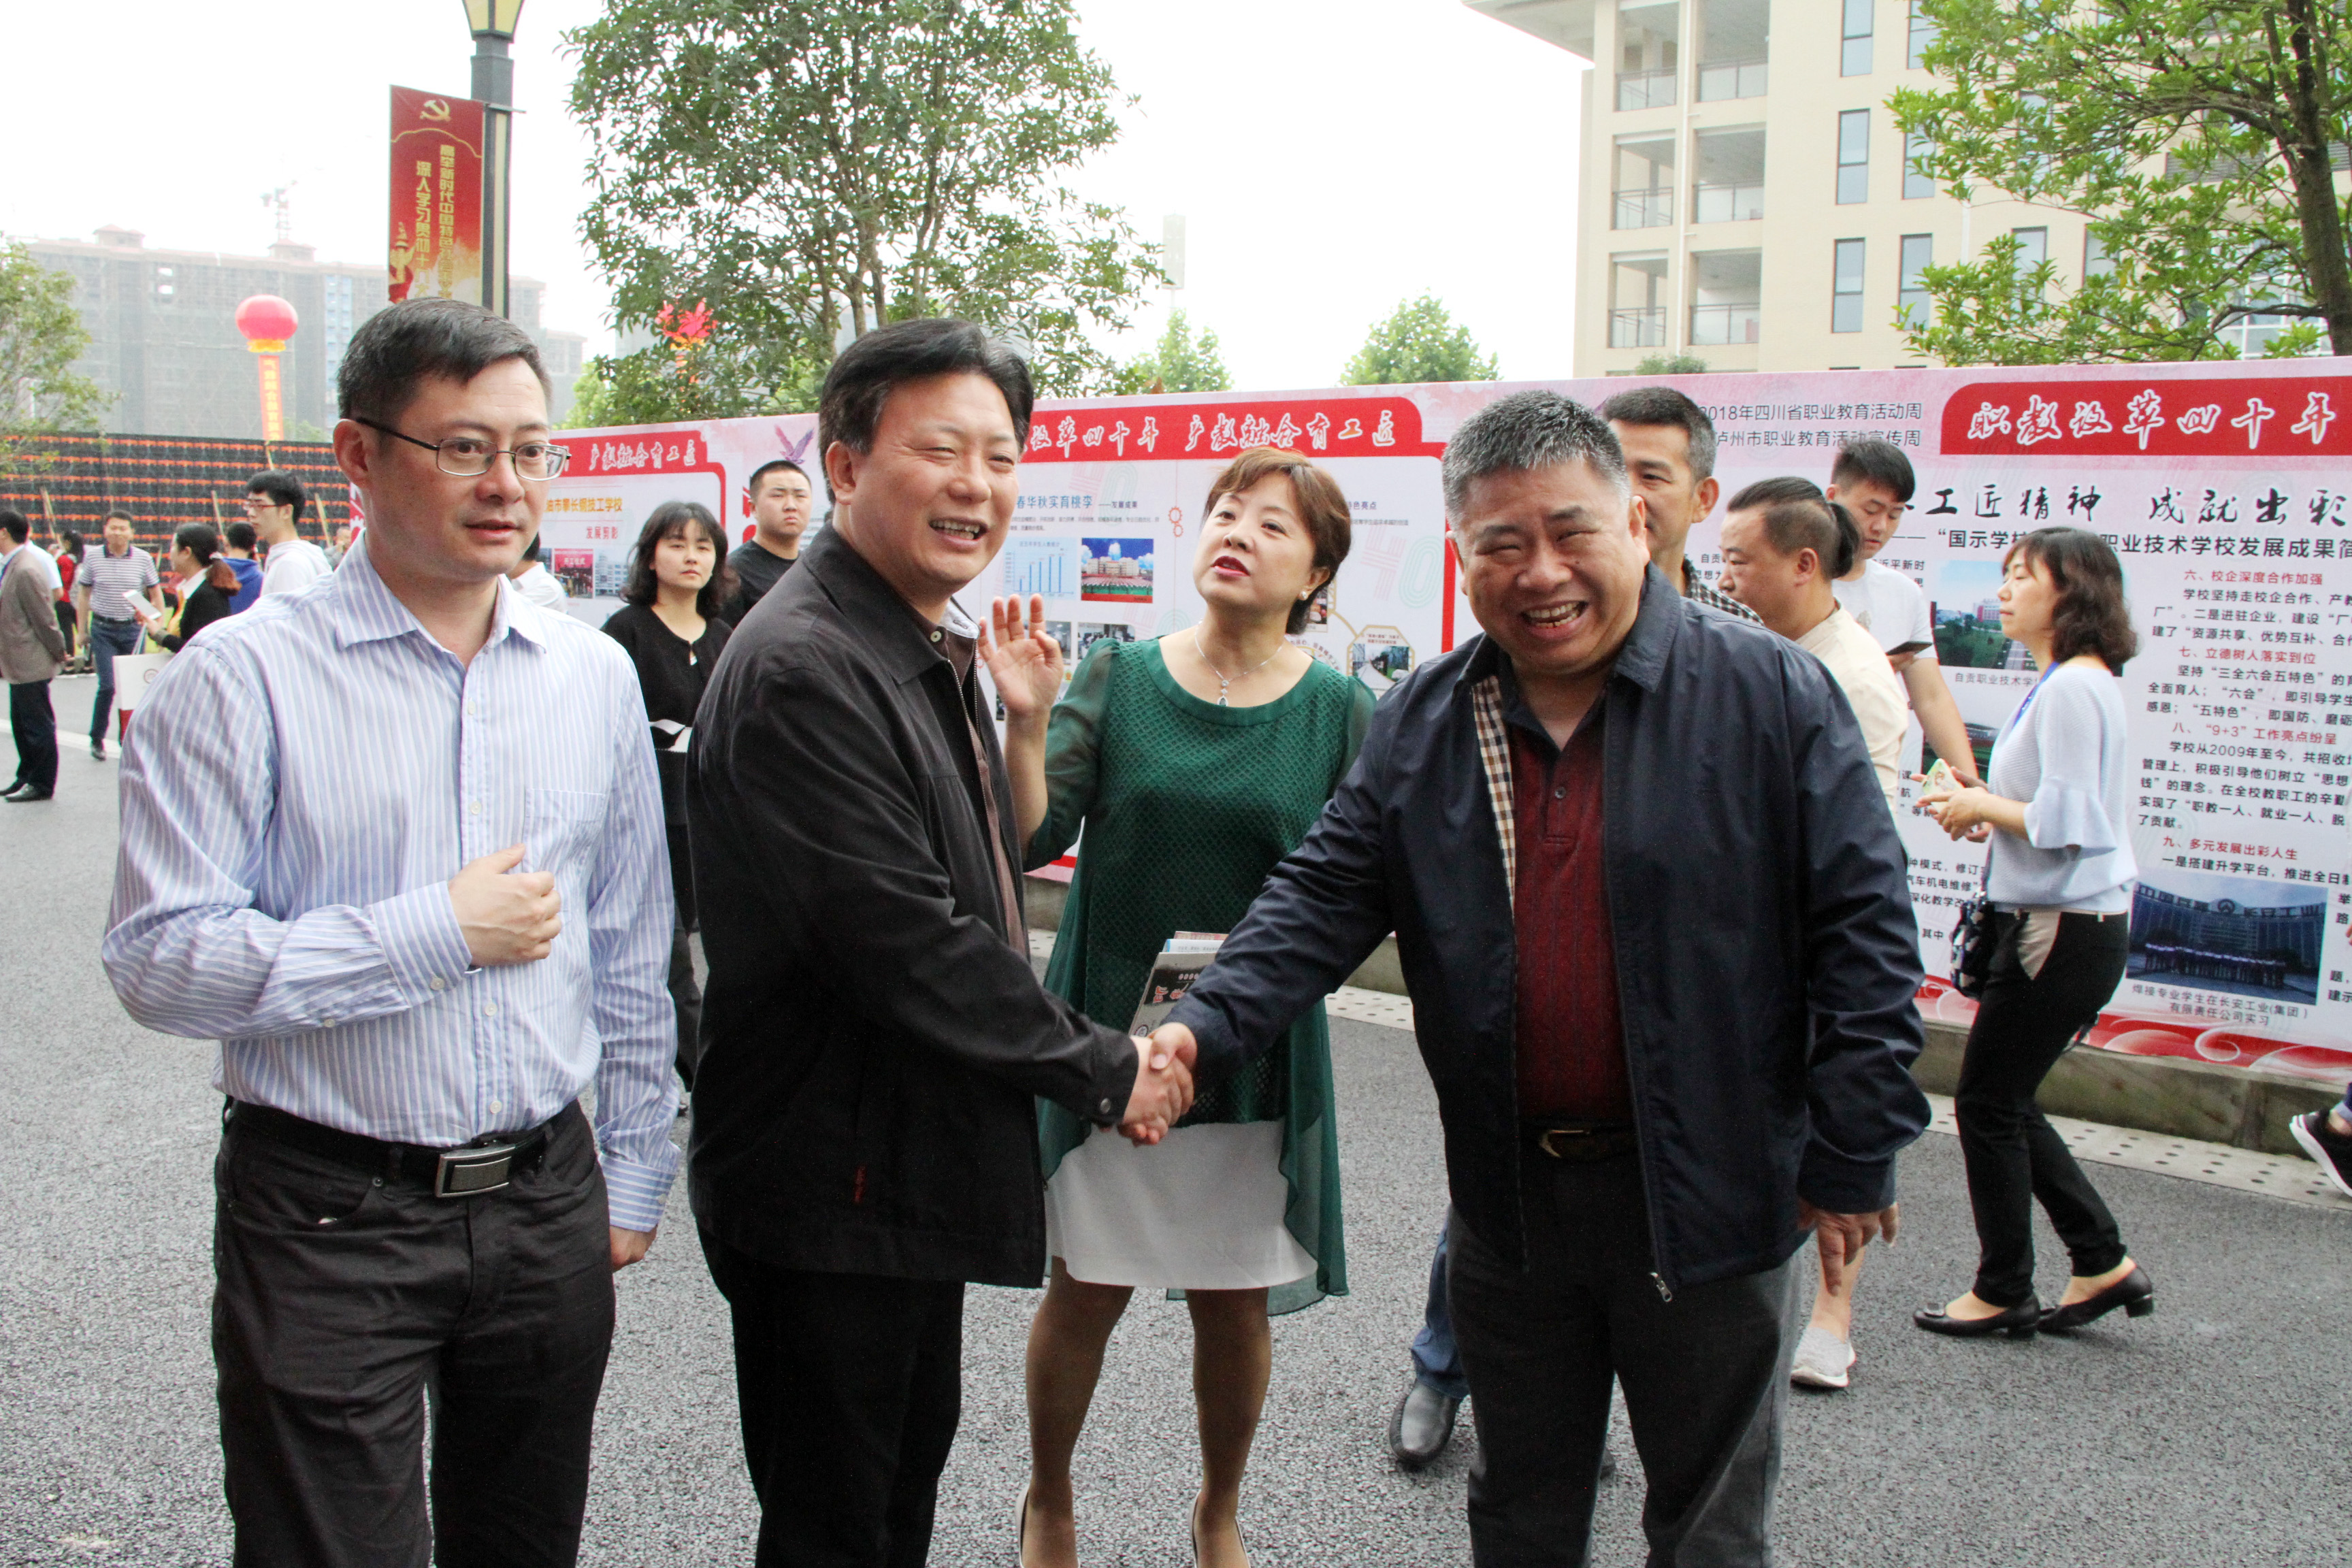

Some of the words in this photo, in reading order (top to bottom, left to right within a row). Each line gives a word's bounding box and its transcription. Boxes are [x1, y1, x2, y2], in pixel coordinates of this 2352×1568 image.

[1023, 416, 1159, 458] 改革四十年
[1906, 485, 2101, 522] 工匠精神
[1873, 559, 1925, 570] 近平新时
[2184, 570, 2323, 585] 六、校企深度合作加强
[2180, 647, 2316, 664] 七、立德树人落实到位
[2163, 836, 2298, 860] 九、多元发展出彩人生
[1923, 928, 1943, 940] 其中
